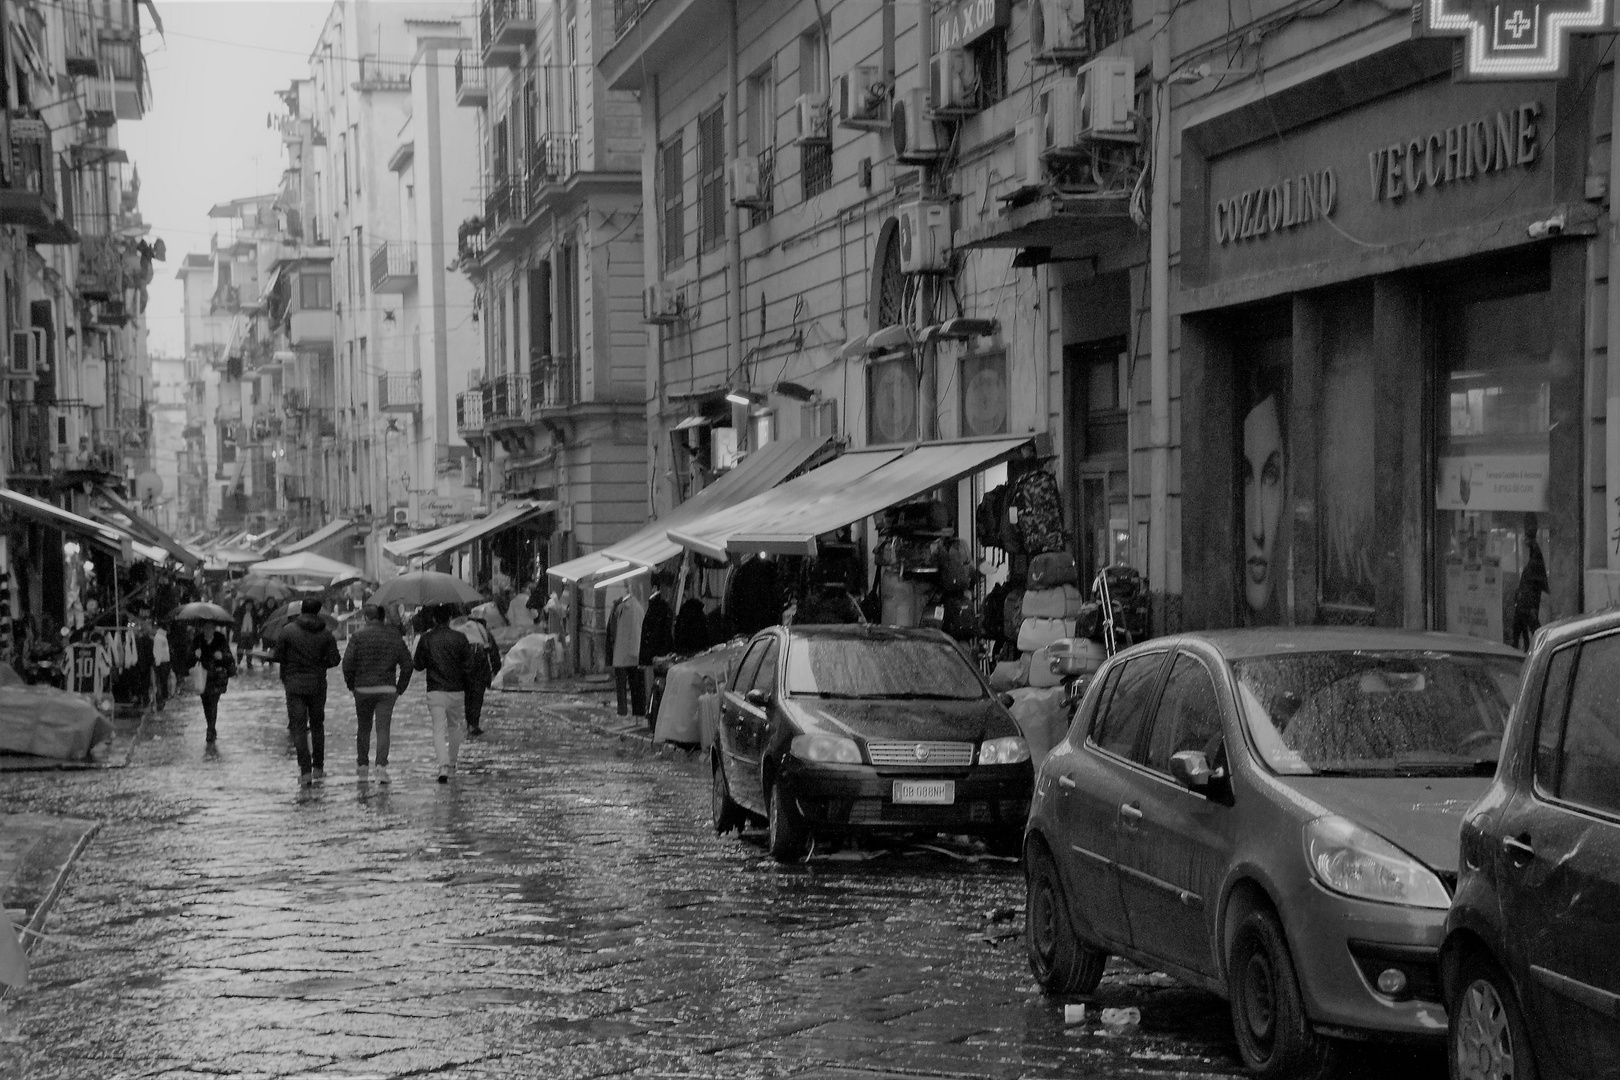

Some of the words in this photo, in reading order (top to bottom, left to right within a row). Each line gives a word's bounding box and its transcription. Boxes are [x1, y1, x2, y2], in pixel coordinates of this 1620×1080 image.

[1215, 168, 1337, 244] COZZOLINO
[1369, 101, 1542, 202] VECCHIONE
[75, 657, 94, 677] 10
